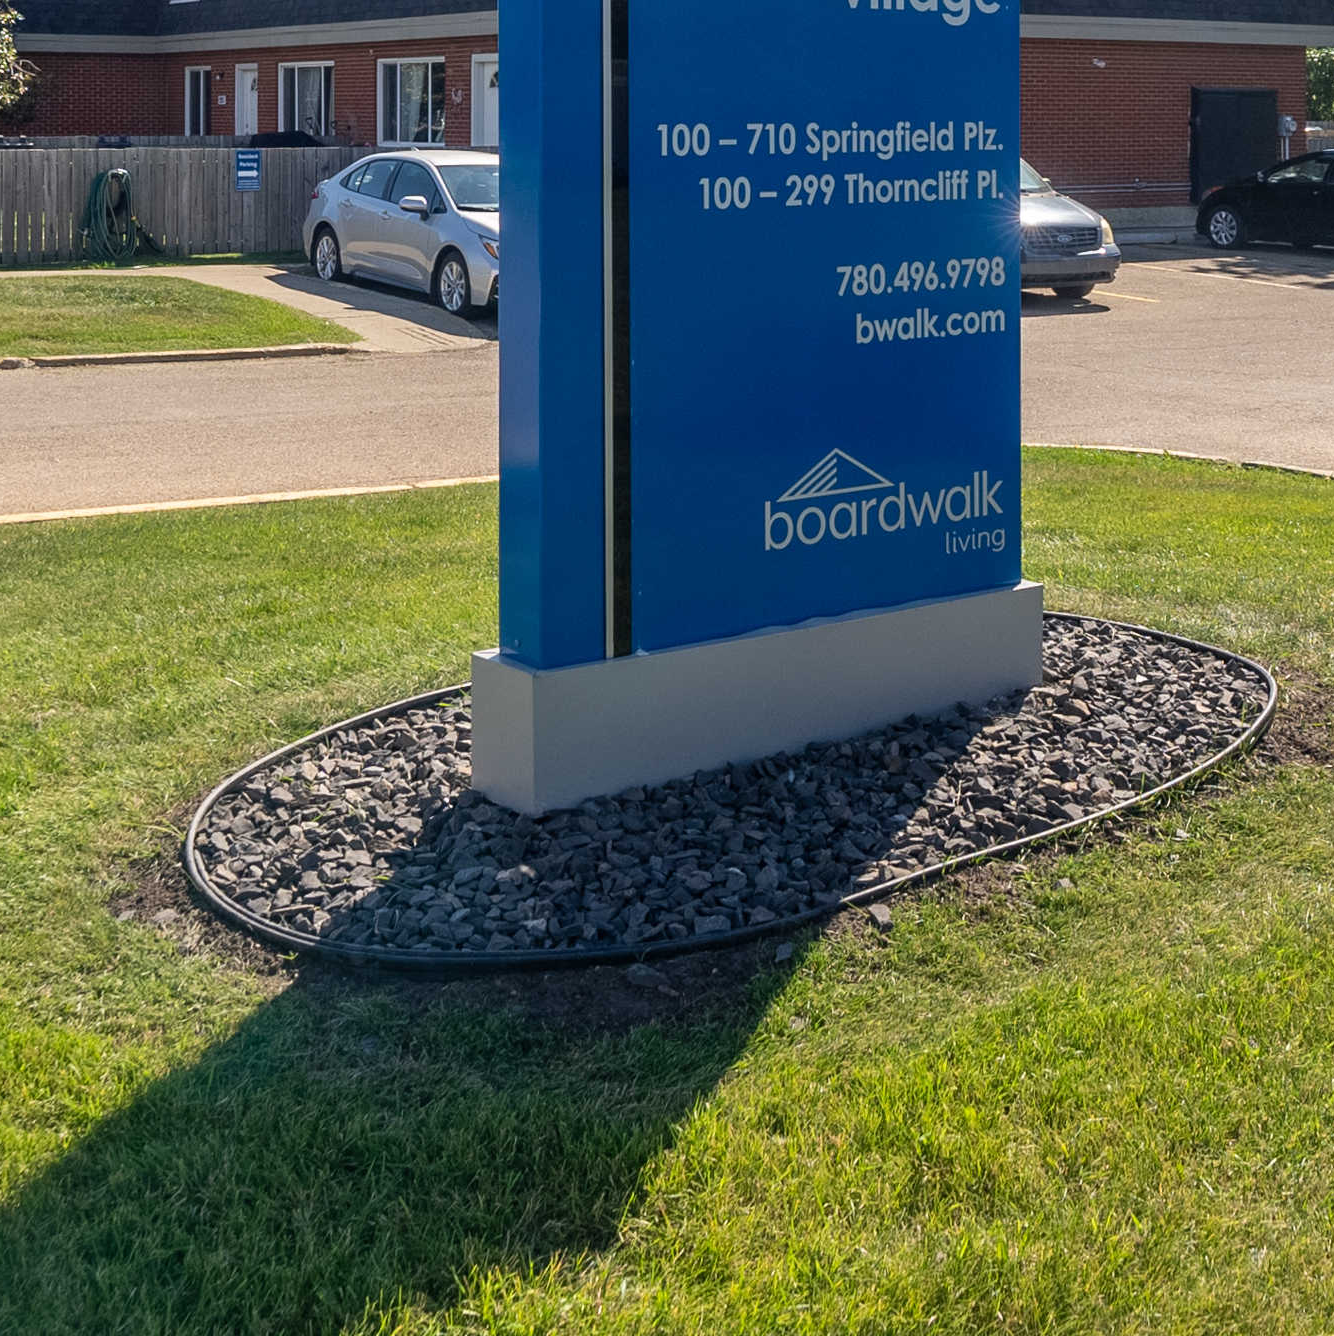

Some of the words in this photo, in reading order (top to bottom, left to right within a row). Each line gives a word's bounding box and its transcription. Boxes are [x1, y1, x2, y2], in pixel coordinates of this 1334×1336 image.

[657, 123, 711, 157] 100
[746, 122, 796, 155] 710
[805, 121, 954, 162] Springfield
[964, 120, 1004, 151] Plz.
[699, 176, 751, 210] 100
[785, 173, 836, 207] 299
[844, 169, 969, 204] Thorncliff
[977, 169, 1004, 200] Pl.
[836, 256, 1006, 297] 780.496.9798
[856, 307, 1006, 344] bwalk.com
[764, 470, 1004, 551] boardwalk
[945, 528, 1006, 554] living
